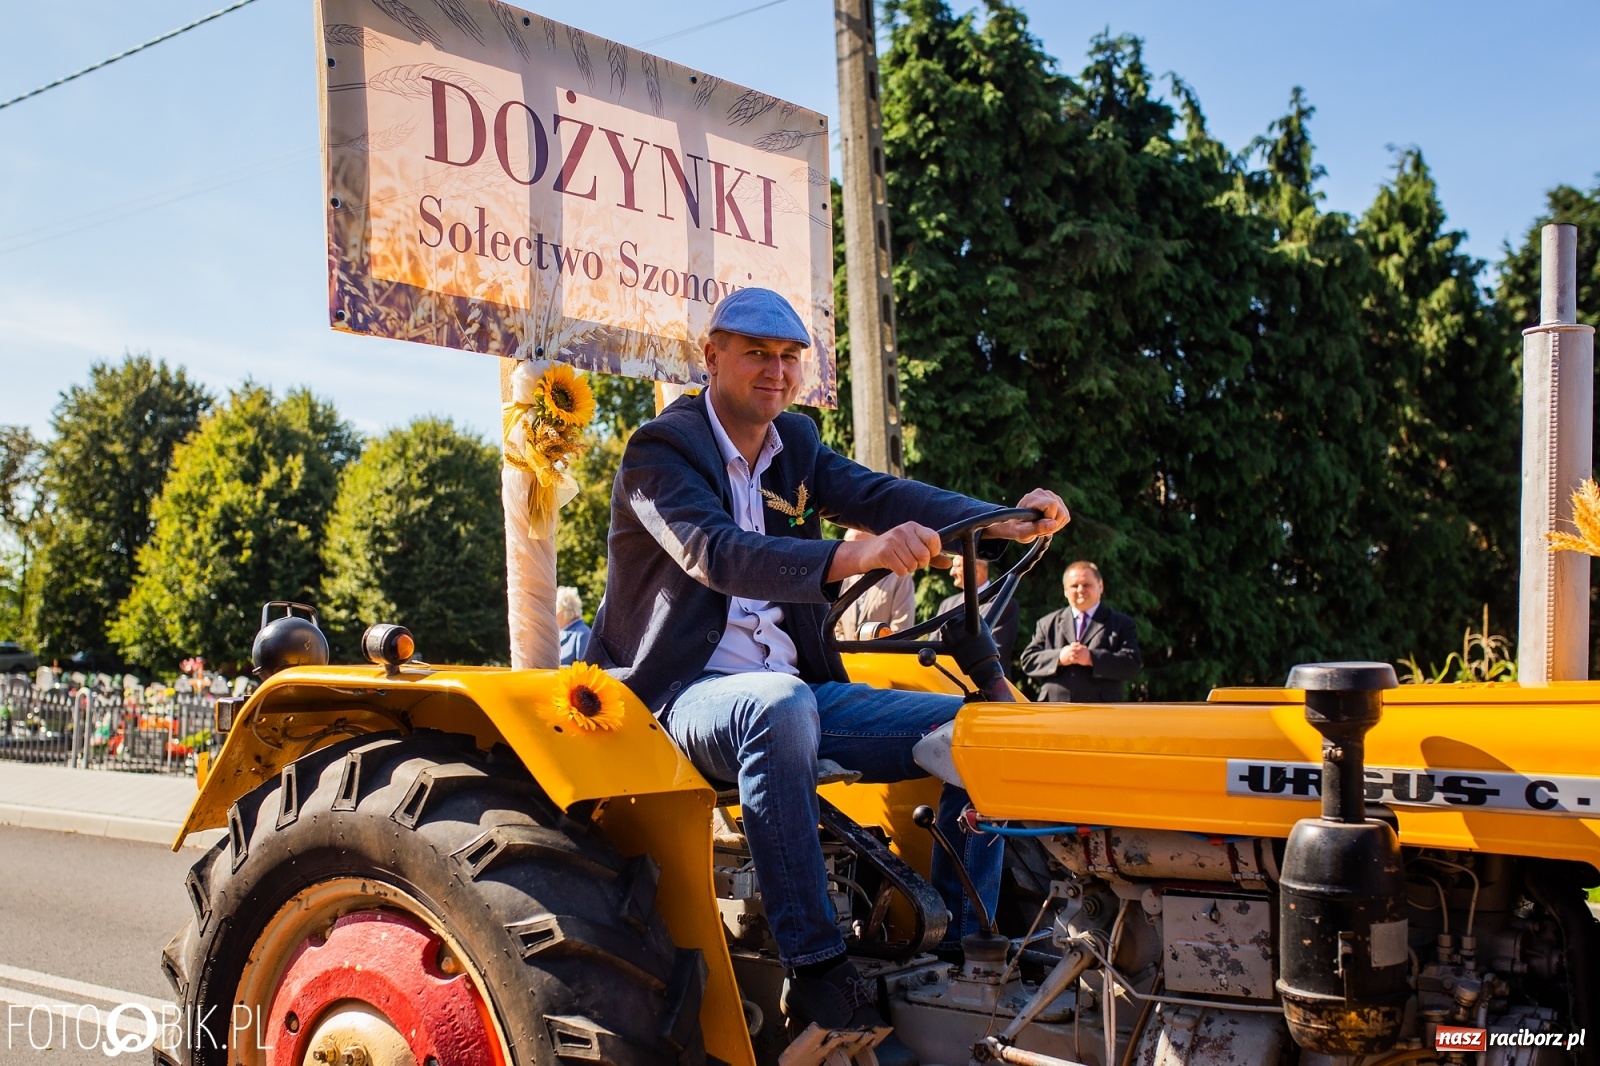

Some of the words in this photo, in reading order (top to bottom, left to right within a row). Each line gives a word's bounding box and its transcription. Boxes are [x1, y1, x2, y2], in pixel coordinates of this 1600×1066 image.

[421, 75, 779, 249] DOŻYNKI
[418, 194, 604, 281] Sołectwo
[619, 240, 753, 305] Szono
